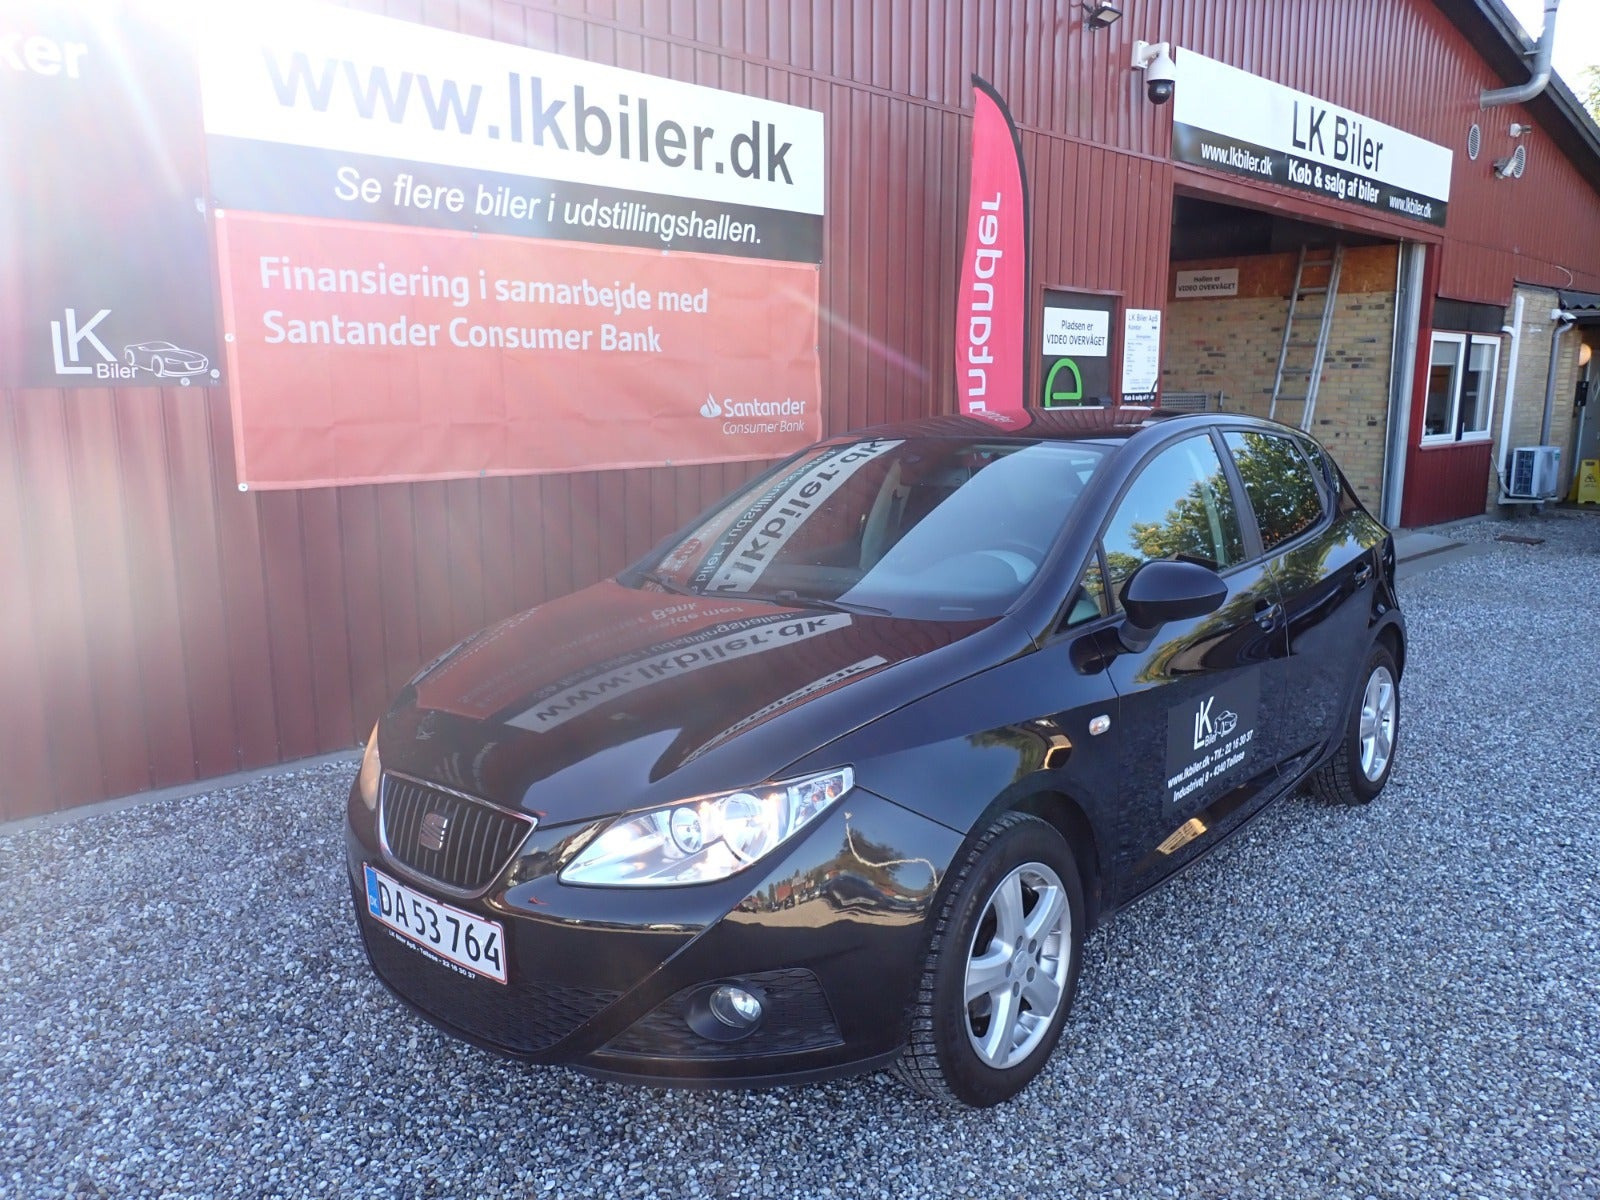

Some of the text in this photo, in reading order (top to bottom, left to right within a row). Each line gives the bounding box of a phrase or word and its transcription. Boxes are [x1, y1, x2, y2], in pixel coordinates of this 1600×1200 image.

[261, 44, 794, 186] www.lkbiler.dk
[1292, 100, 1384, 172] LK Biler
[1201, 142, 1272, 176] www.lkbiler.dk
[1288, 159, 1379, 204] Køb & salg af biler
[334, 166, 761, 244] Se flere biler i udstillingshallen.
[1389, 194, 1432, 219] www.lkbiler.dk
[259, 256, 708, 316] Finansiering i samarbejde med
[51, 308, 139, 378] LK Biler
[262, 310, 663, 352] Santander Consumer Bank
[1046, 333, 1106, 346] VIDEO OVERVÅGET
[1061, 320, 1094, 331] Pladsen er
[722, 419, 805, 435] Consumer Bank
[723, 397, 806, 418] Santander
